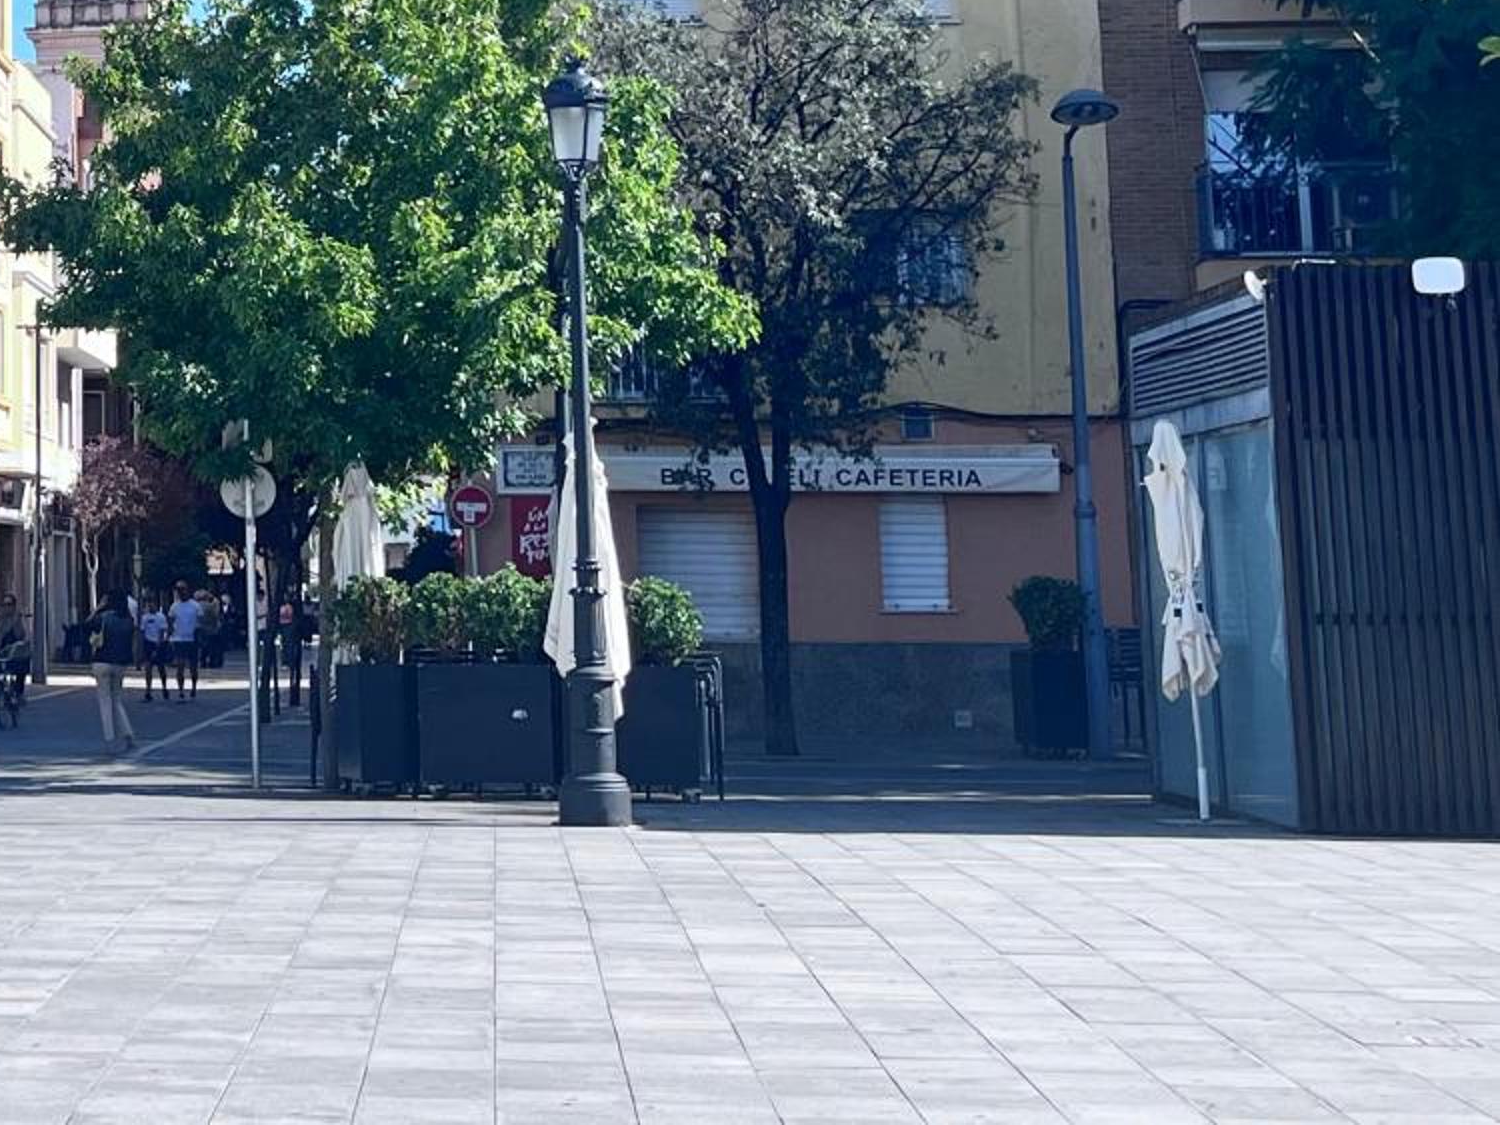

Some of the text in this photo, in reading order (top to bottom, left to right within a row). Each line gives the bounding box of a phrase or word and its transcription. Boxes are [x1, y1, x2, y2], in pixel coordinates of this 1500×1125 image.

[661, 468, 982, 487] BR CELI CAFETERIA
